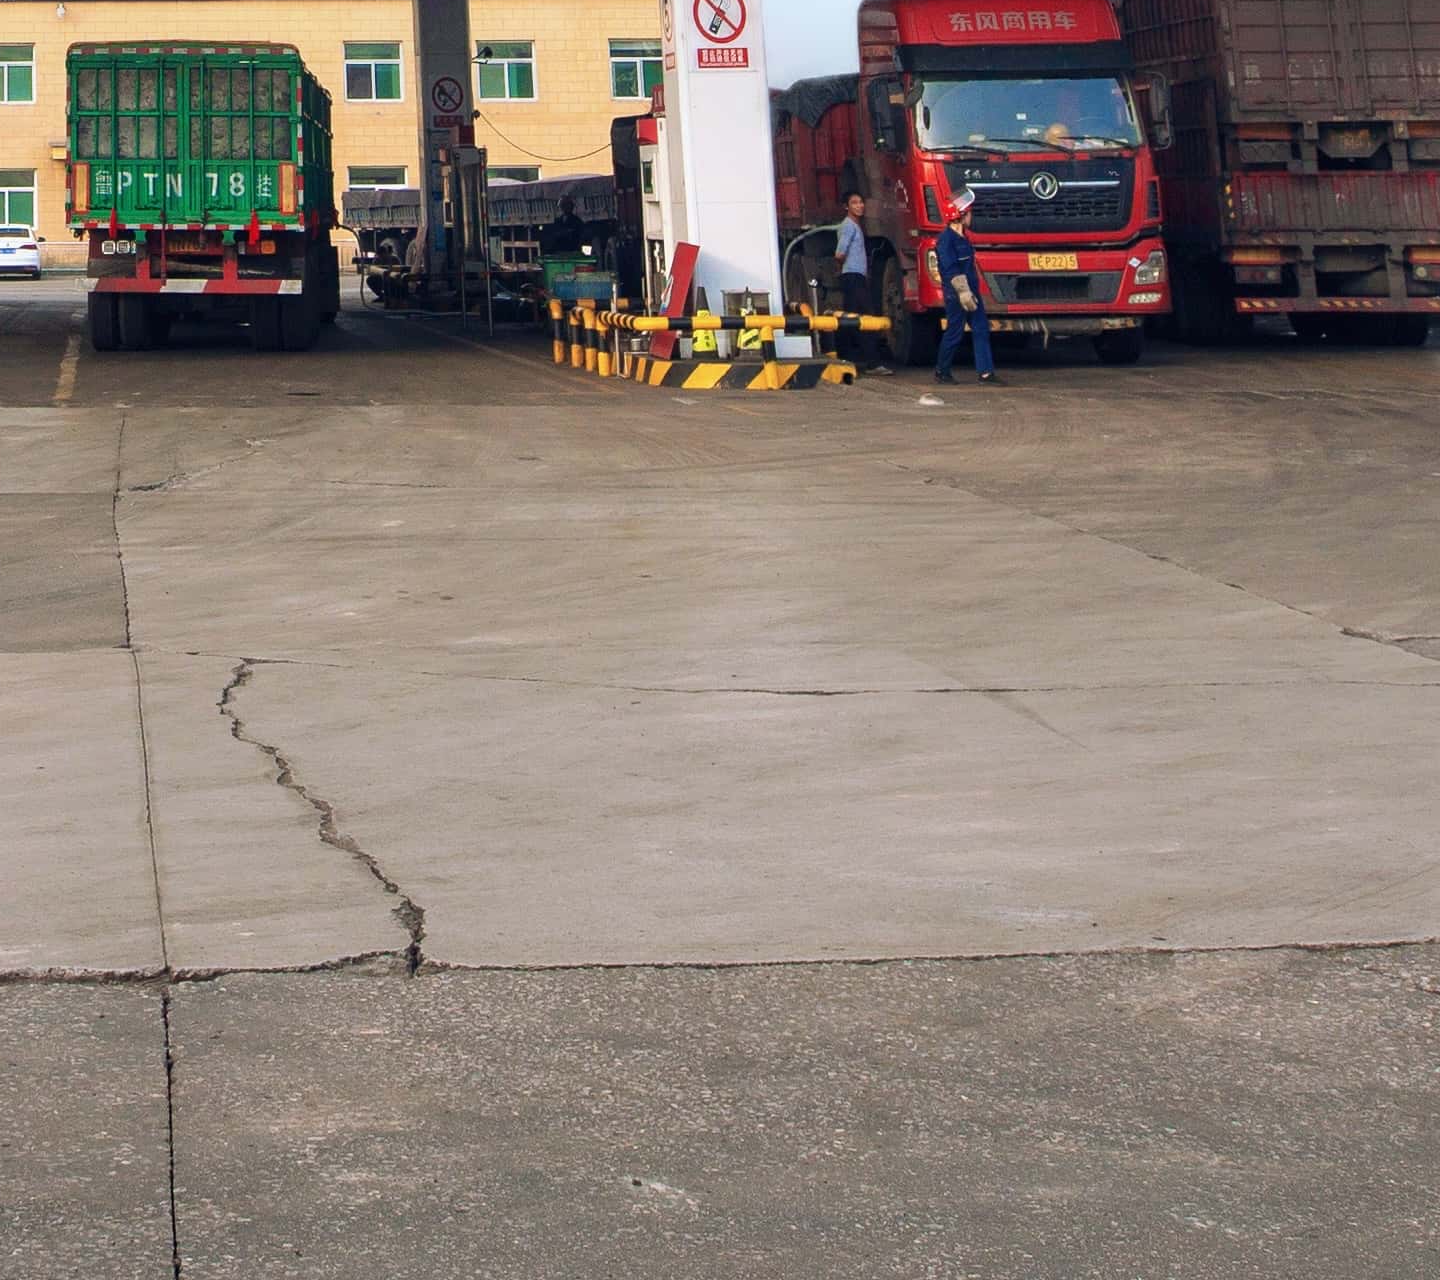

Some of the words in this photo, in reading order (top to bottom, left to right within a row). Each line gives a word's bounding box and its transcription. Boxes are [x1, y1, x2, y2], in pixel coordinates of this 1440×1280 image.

[949, 11, 1077, 32] 东风商用车
[96, 170, 272, 197] 鲁PTN78挂
